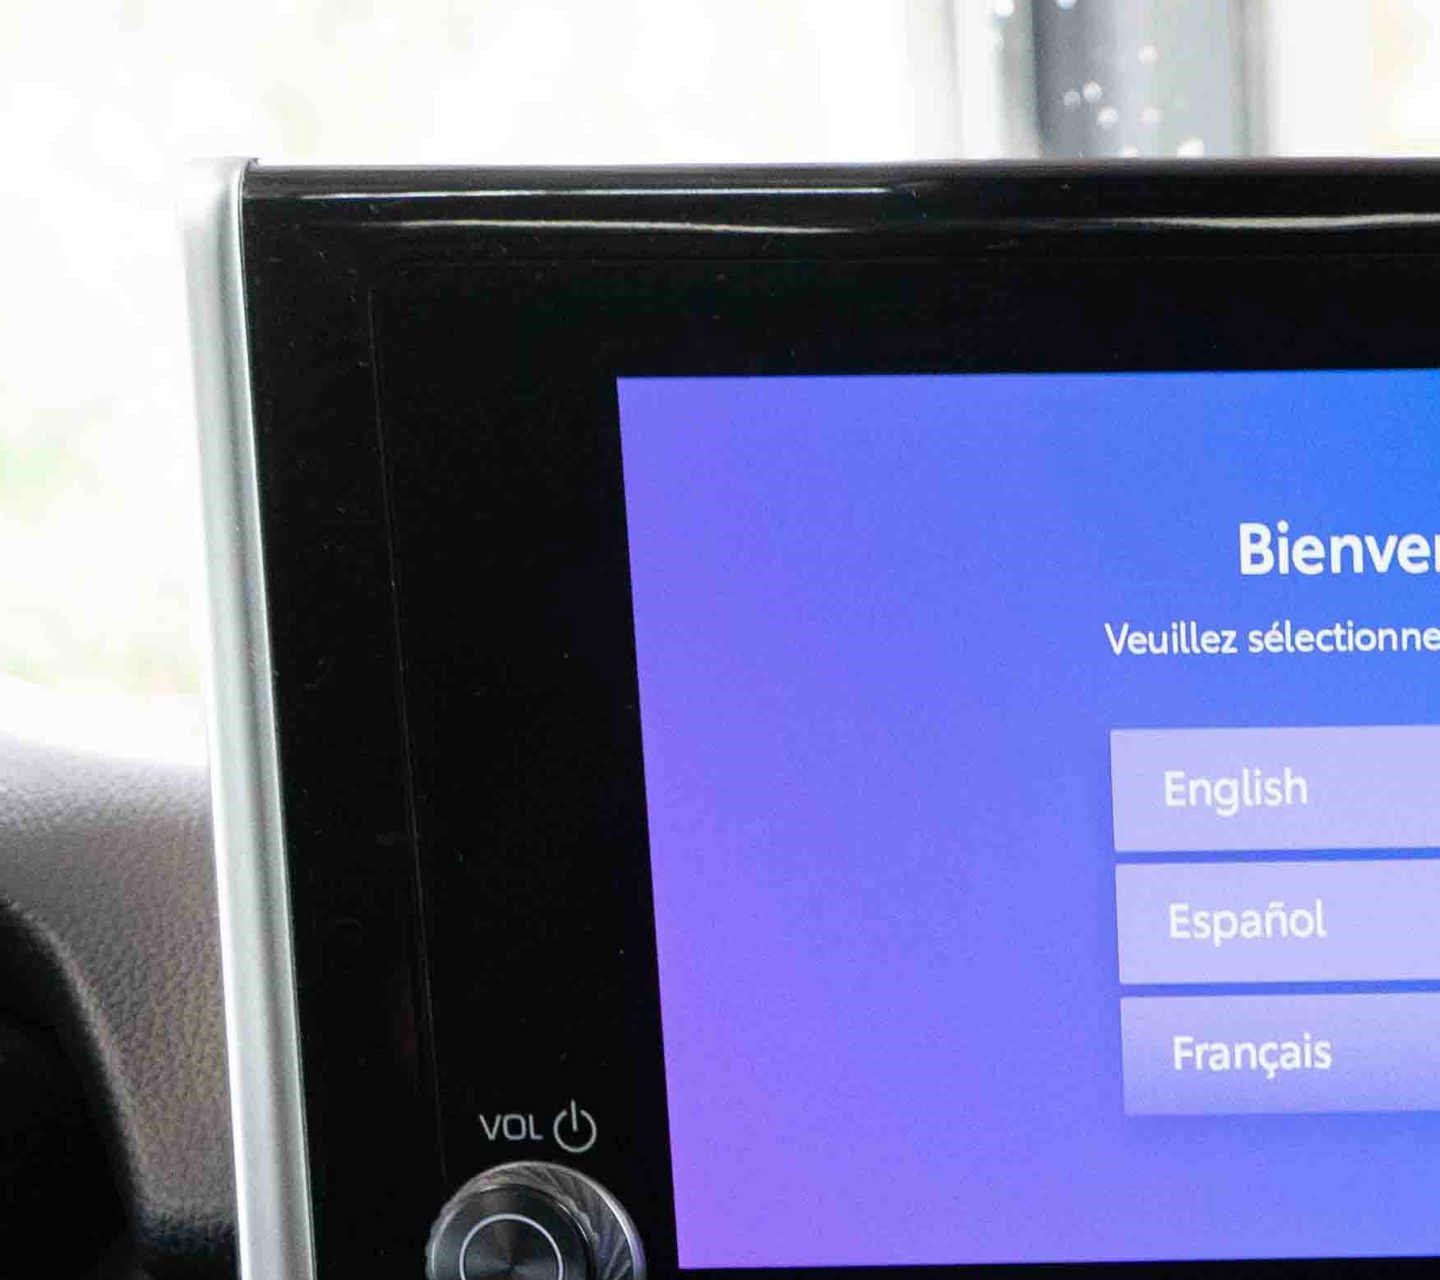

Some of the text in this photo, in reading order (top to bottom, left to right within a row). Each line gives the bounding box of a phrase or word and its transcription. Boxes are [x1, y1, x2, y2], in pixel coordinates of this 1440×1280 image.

[1104, 620, 1238, 656] Veuillez
[1164, 767, 1308, 818] English
[1169, 898, 1327, 948] Español
[1172, 1031, 1333, 1080] Français
[479, 1113, 543, 1141] VOL
